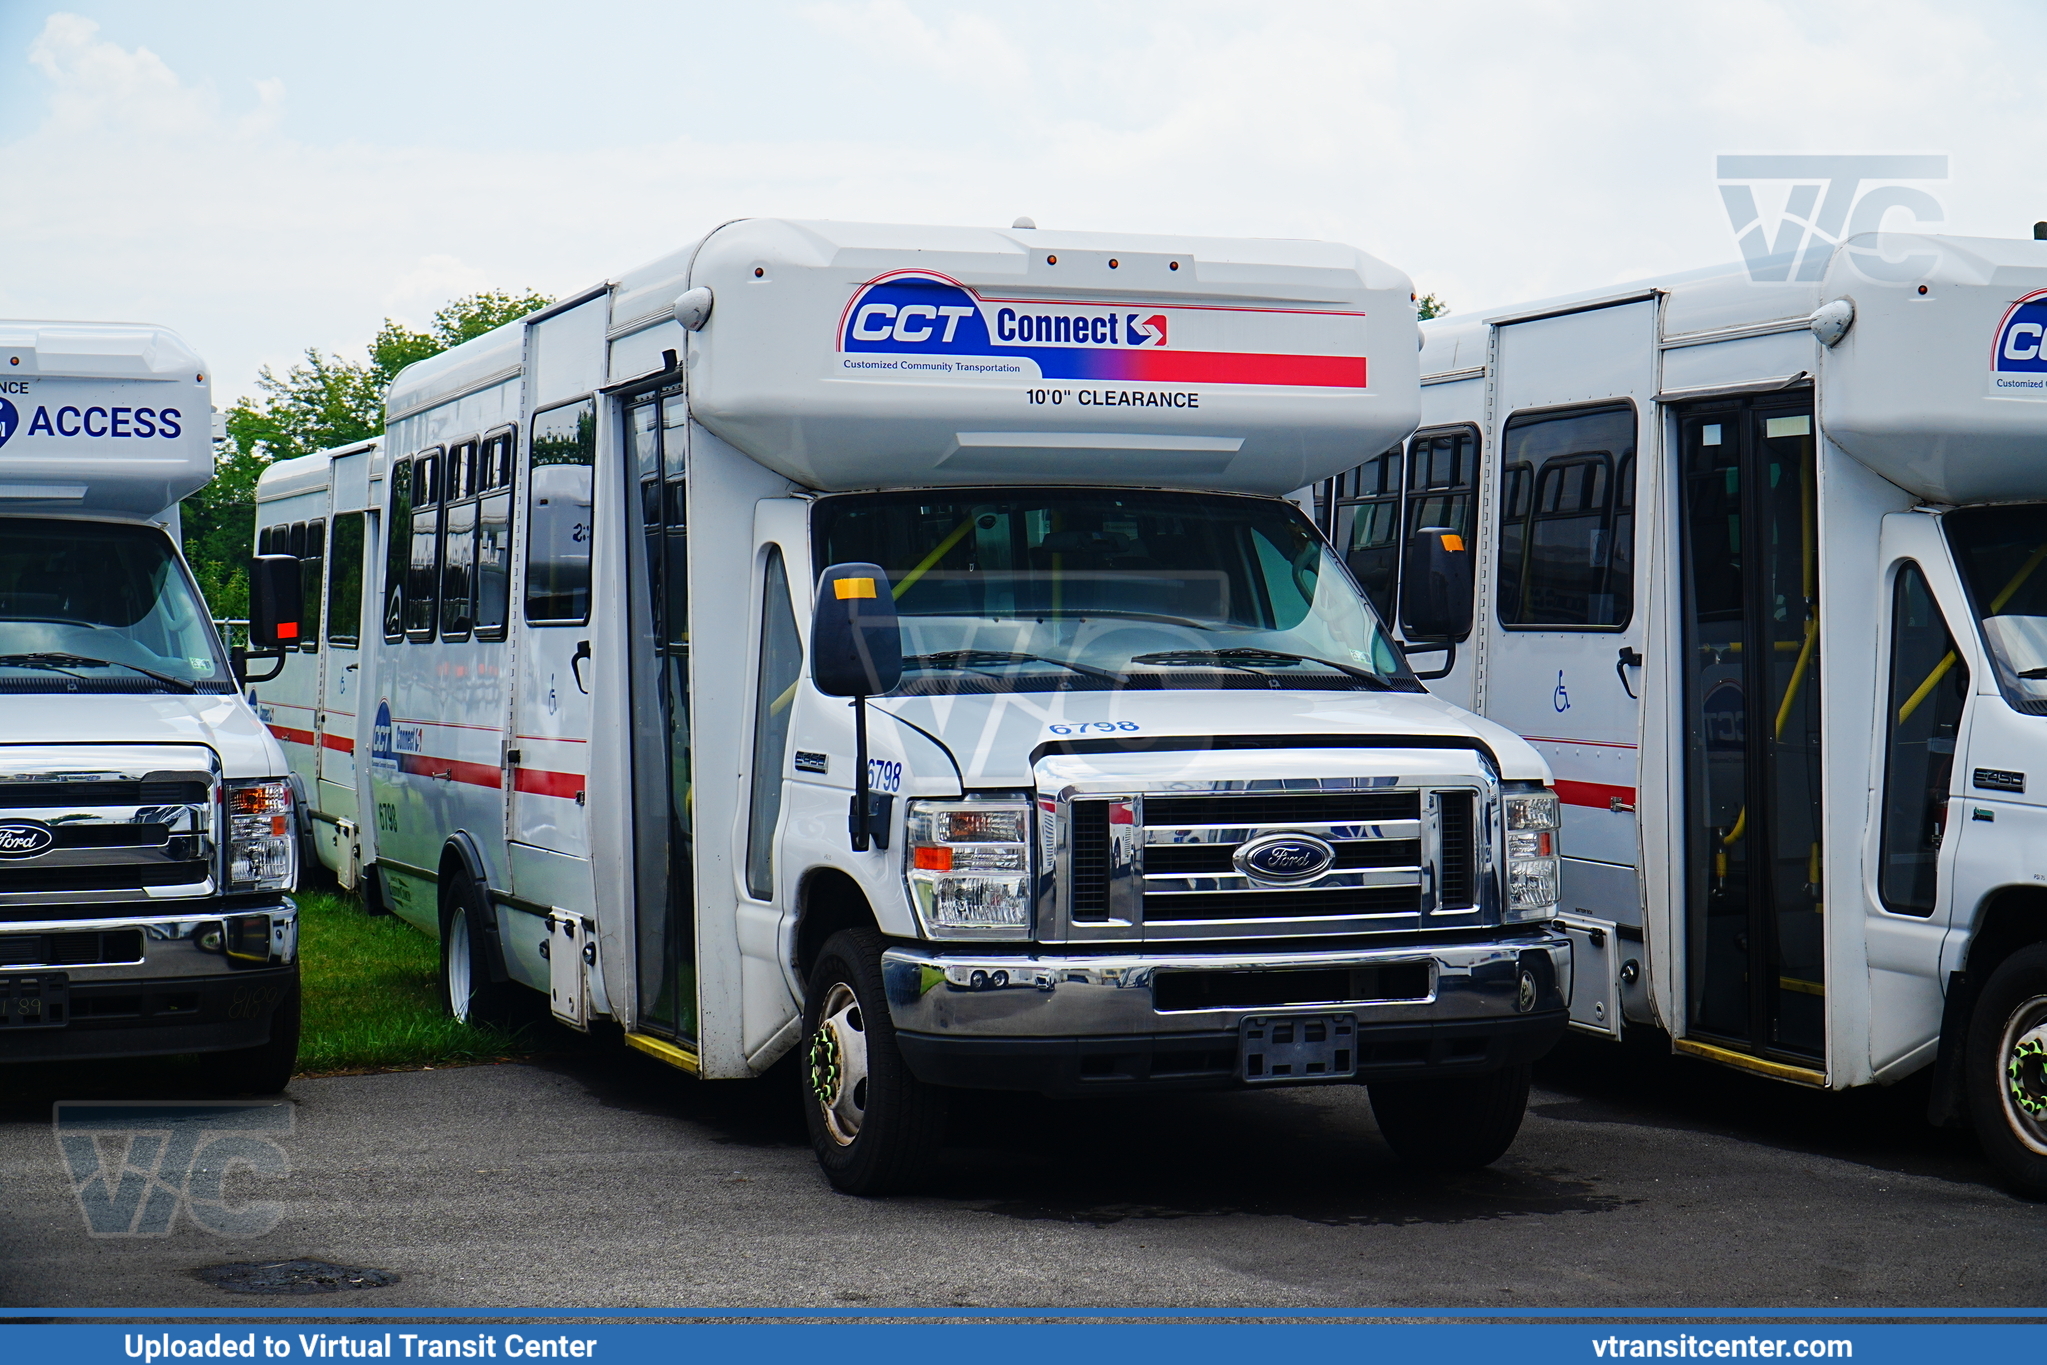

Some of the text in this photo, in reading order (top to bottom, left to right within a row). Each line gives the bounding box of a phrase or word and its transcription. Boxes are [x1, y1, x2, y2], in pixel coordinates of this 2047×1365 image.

[852, 303, 1118, 345] CCT Connect
[2003, 322, 2047, 361] C
[843, 359, 1021, 374] Customized Community Transportation
[1996, 378, 2043, 389] Customized
[1026, 388, 1200, 409] 10'0" CLEARANCE
[28, 405, 182, 439] ACCESS
[373, 725, 391, 752] CCT
[1049, 720, 1140, 736] 6798
[867, 758, 902, 793] 6798
[378, 802, 398, 833] 6798
[0, 829, 38, 848] Ford
[1267, 847, 1310, 868] Ford
